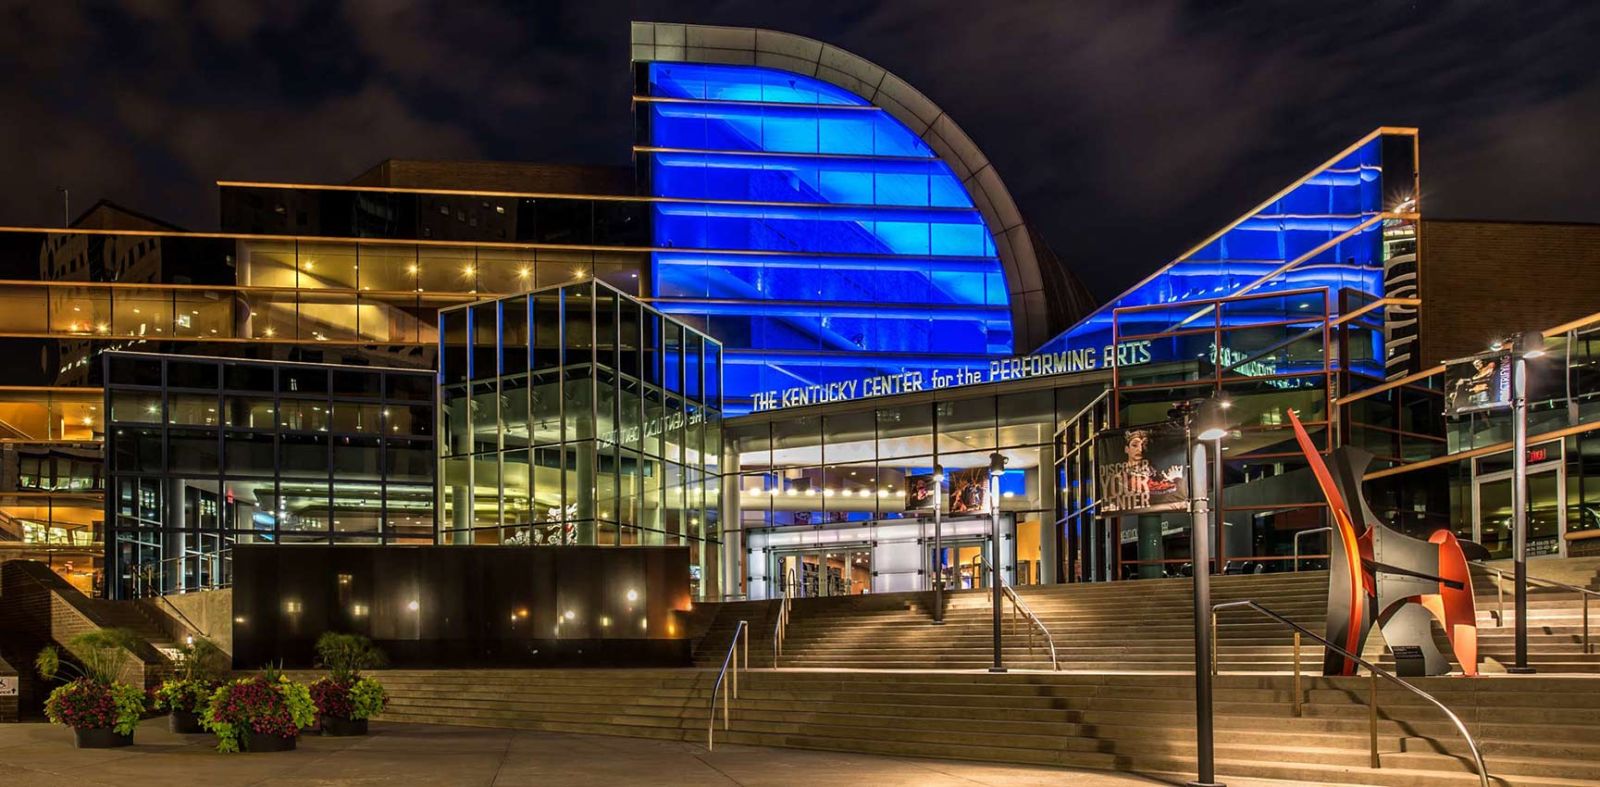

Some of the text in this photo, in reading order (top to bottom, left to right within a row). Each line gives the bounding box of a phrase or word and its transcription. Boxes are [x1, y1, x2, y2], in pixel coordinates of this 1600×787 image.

[750, 340, 1152, 411] THE KENTUCKY CENTER for the PERFORMING ARTS
[1100, 474, 1150, 502] YOUR
[1100, 492, 1150, 512] CENTER
